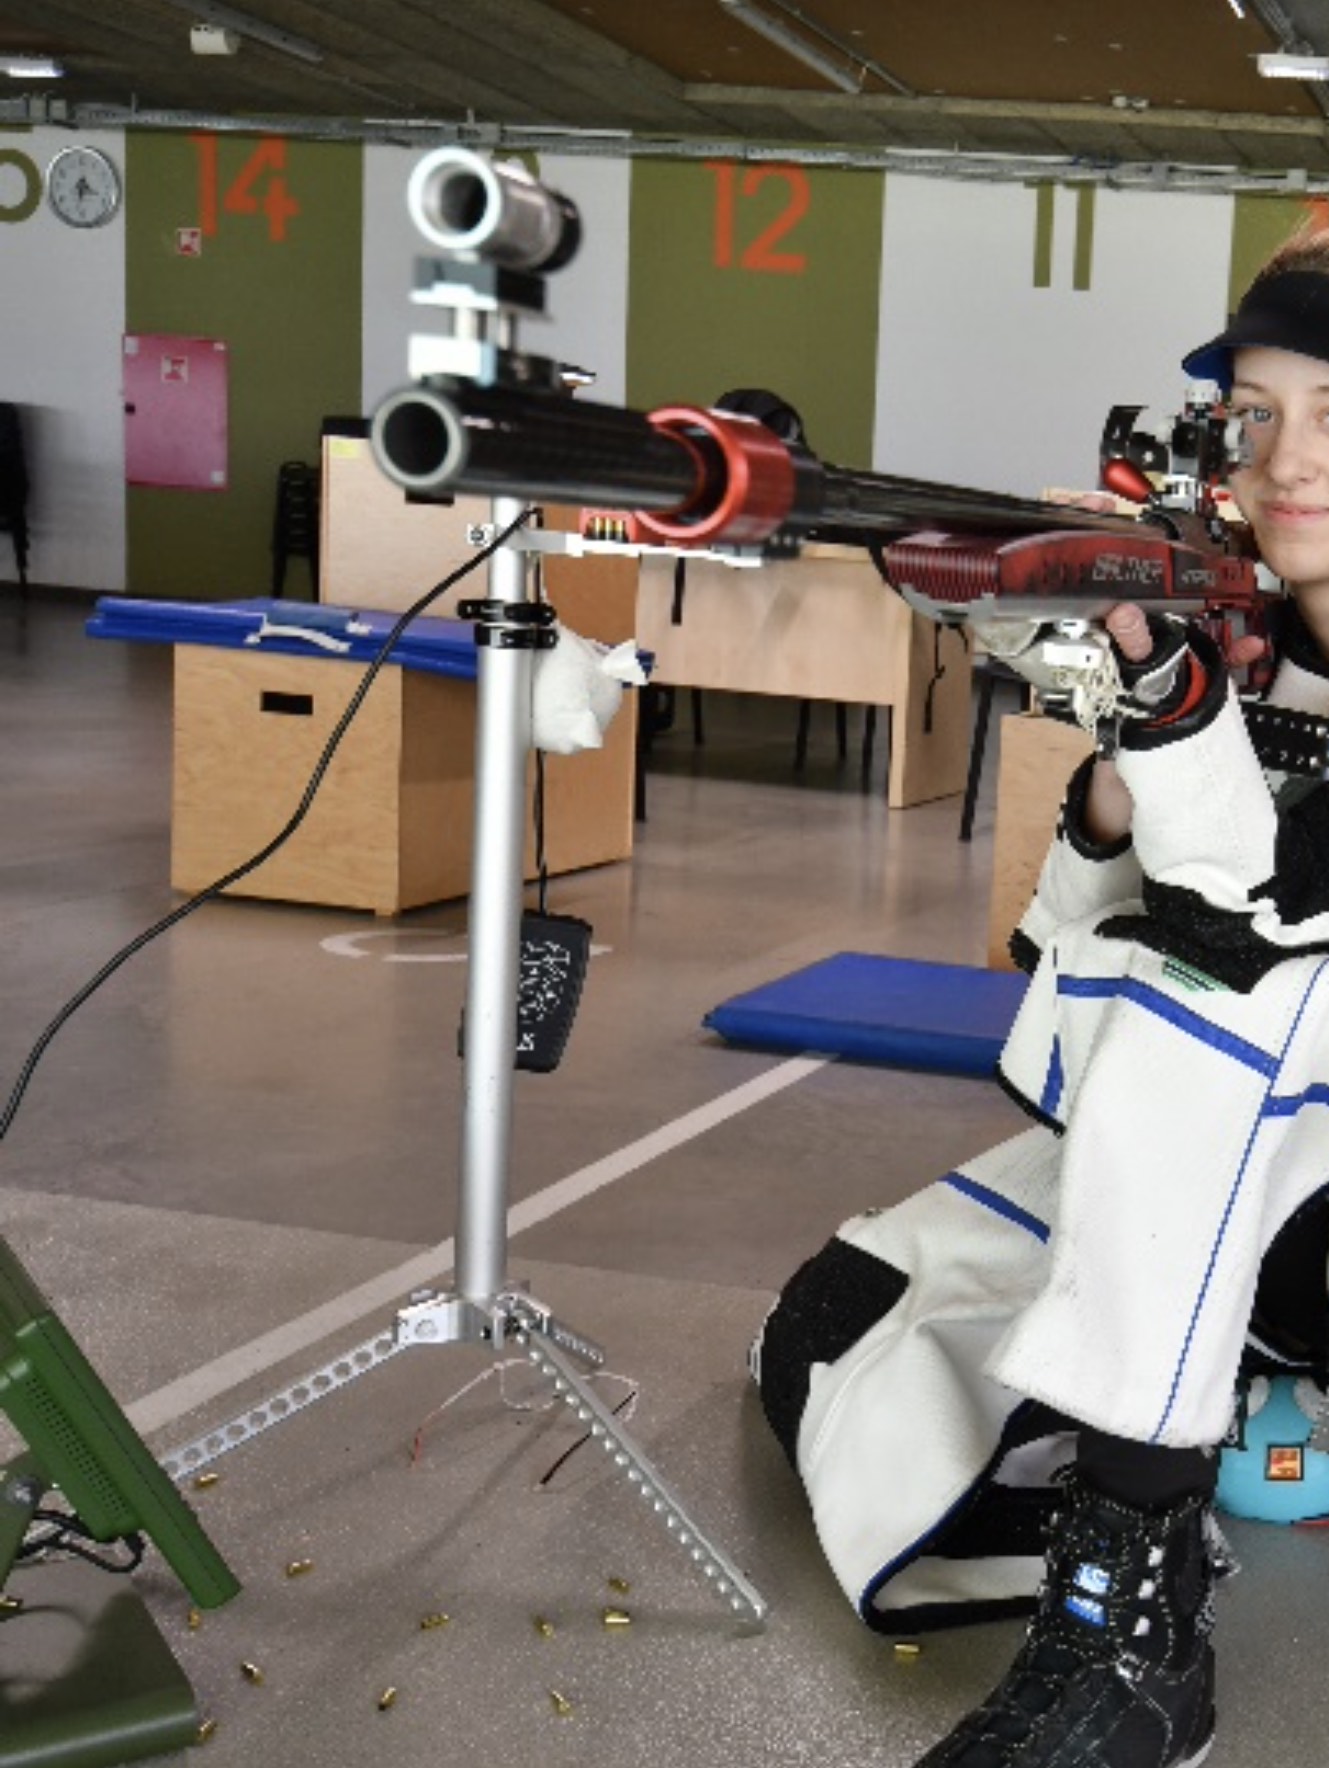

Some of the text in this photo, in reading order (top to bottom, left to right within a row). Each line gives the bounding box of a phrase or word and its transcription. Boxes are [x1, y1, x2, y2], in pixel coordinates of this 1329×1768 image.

[187, 130, 300, 242] 14
[703, 156, 811, 273] 12
[1023, 177, 1098, 291] 11
